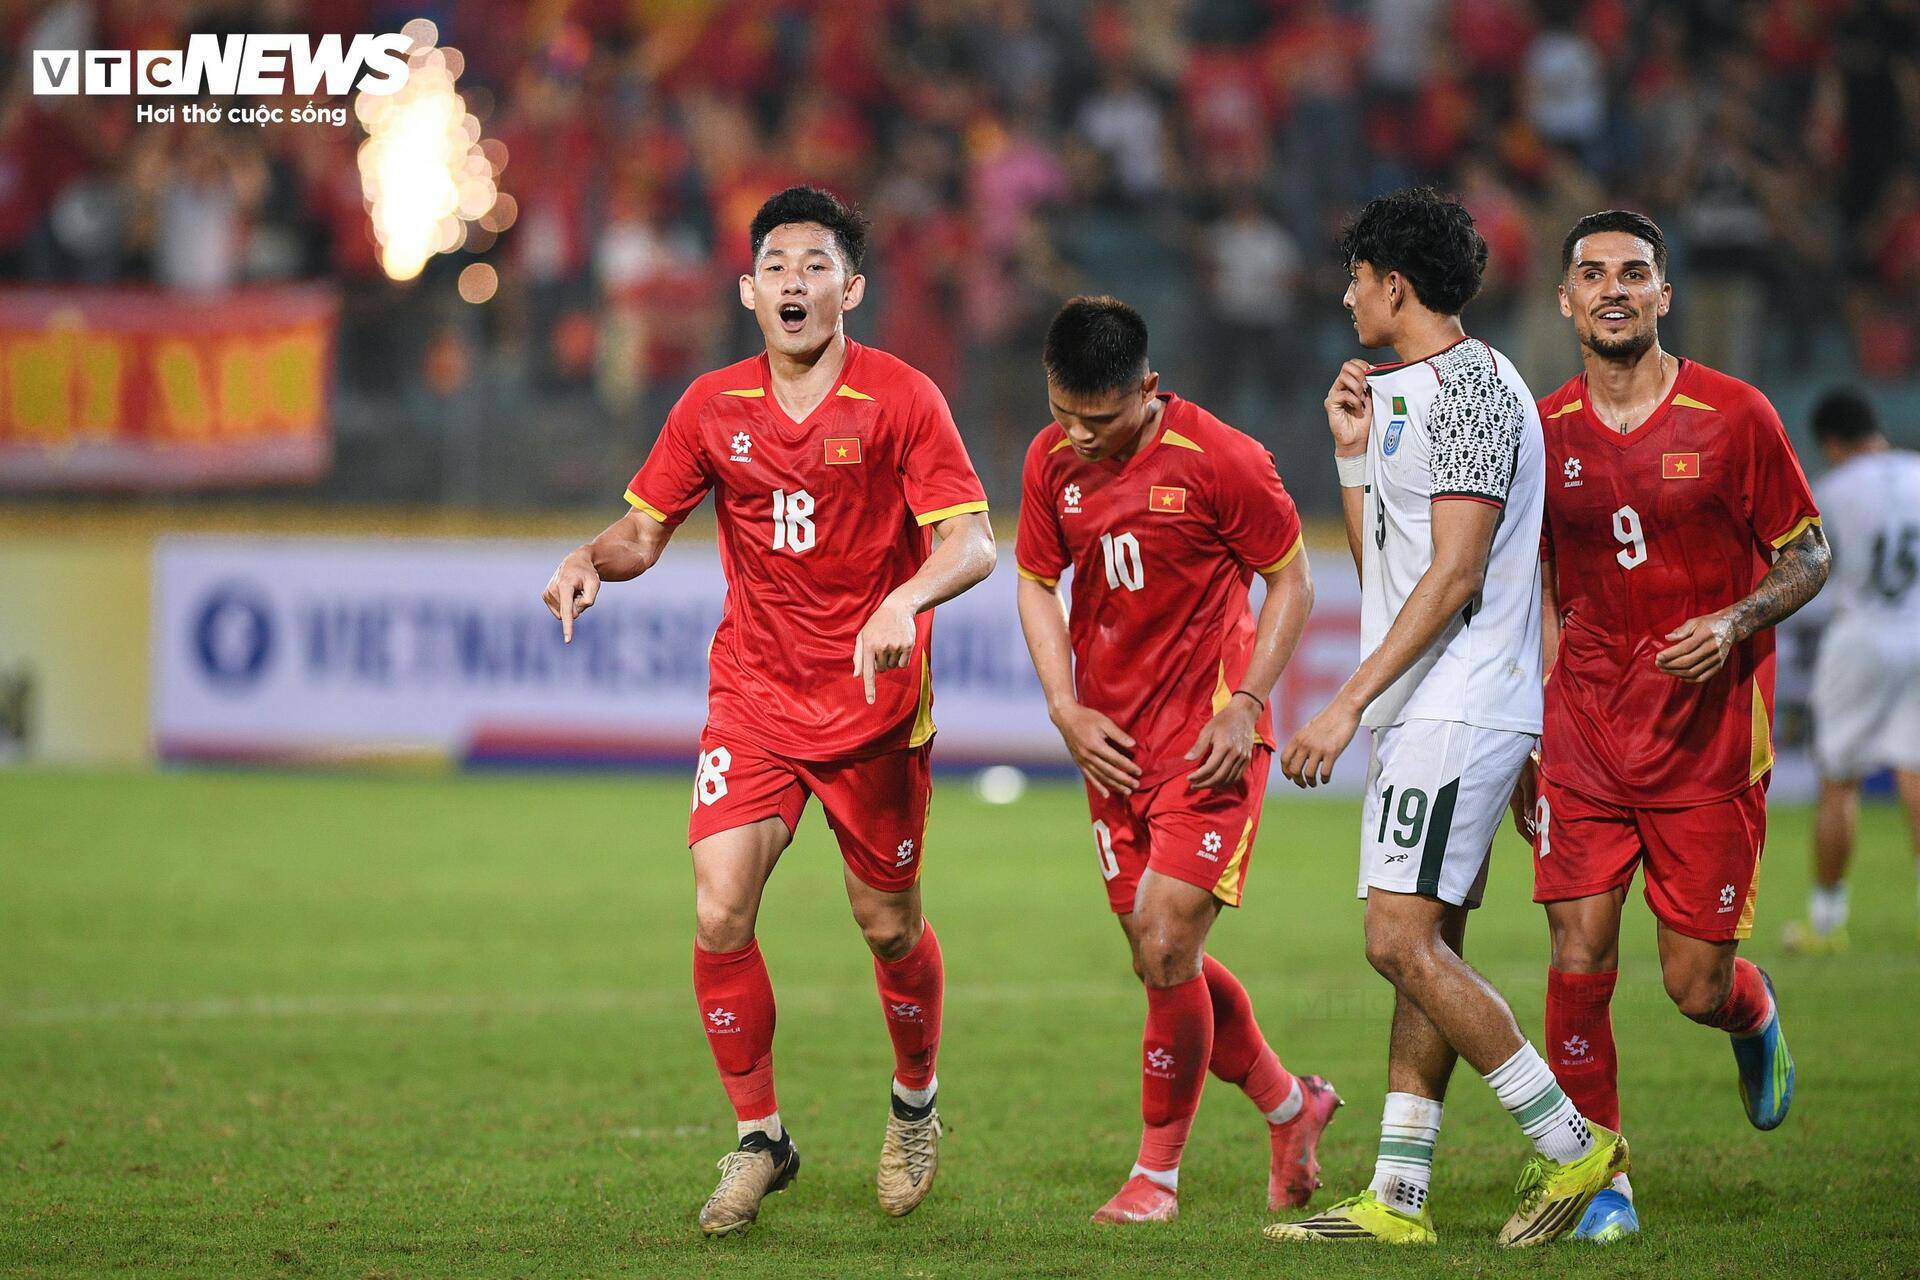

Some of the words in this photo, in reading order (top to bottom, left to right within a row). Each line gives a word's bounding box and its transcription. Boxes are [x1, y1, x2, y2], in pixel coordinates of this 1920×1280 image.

[772, 488, 816, 553] 18
[1612, 504, 1648, 571] 9
[1099, 531, 1145, 592] 10
[1377, 784, 1429, 849] 19
